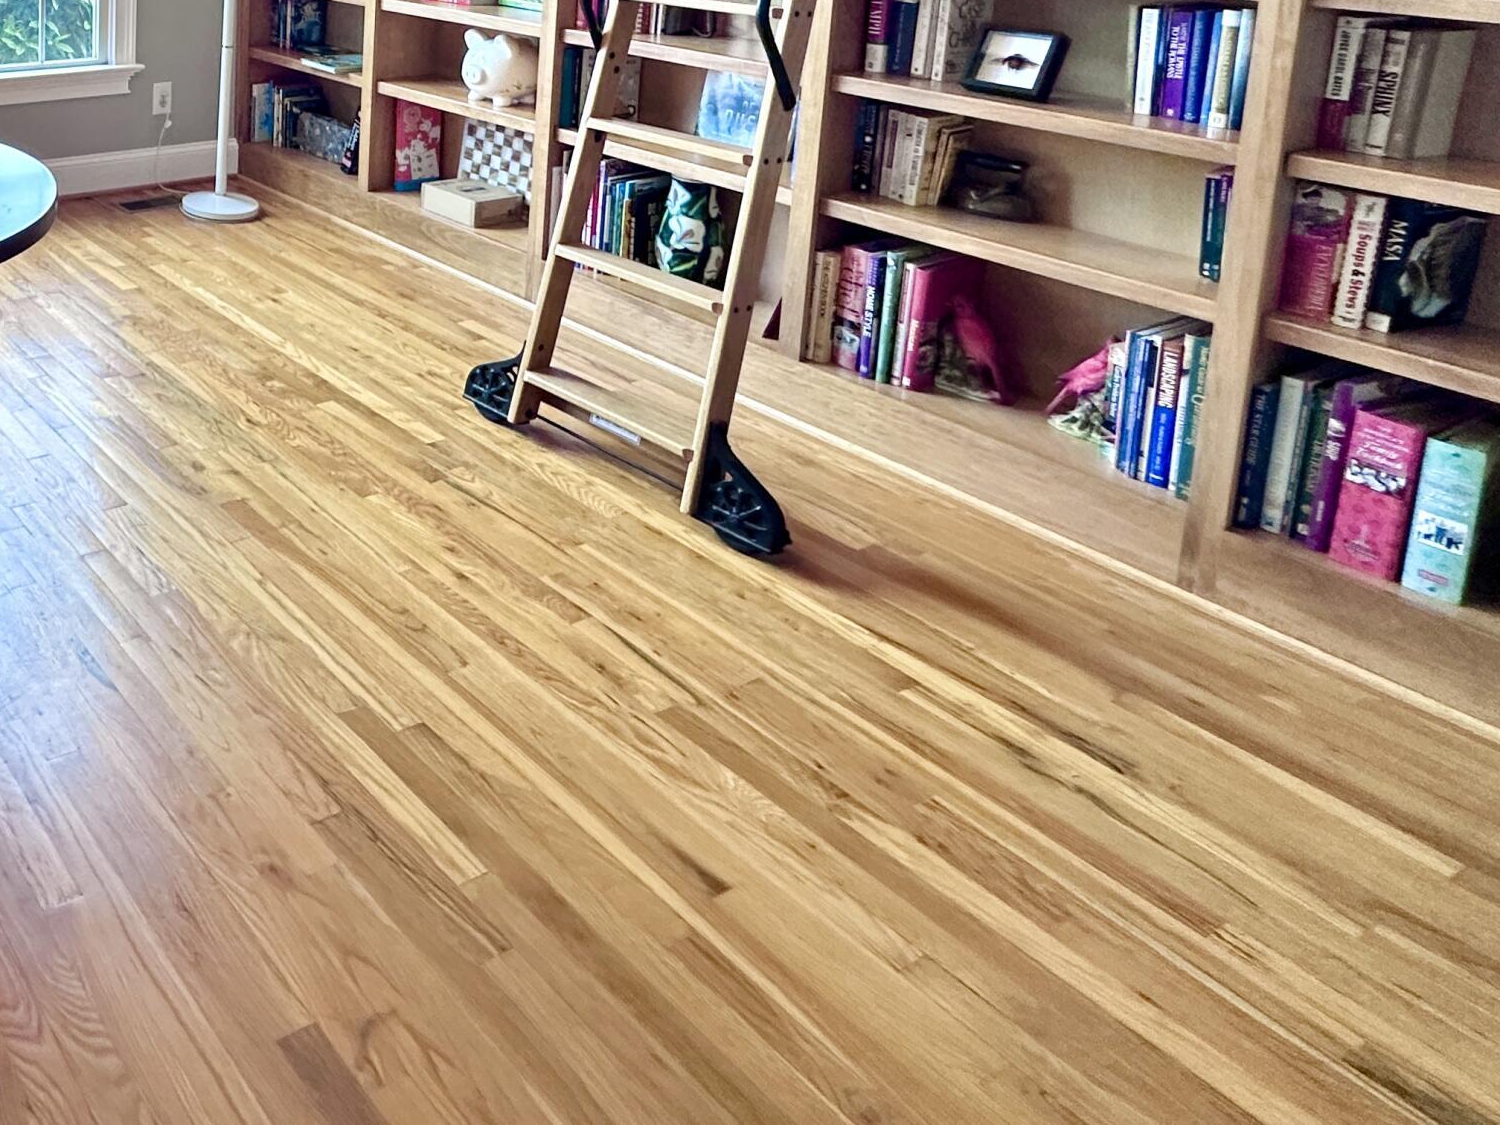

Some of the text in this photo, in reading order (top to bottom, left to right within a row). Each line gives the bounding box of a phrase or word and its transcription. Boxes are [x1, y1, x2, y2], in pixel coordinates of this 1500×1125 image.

[1371, 70, 1399, 118] SPHINX
[1382, 219, 1408, 262] MASA
[1344, 233, 1373, 310] Soups & Stews
[864, 286, 876, 312] HOME
[861, 310, 873, 339] STYLE
[1157, 351, 1179, 409] LANDSCAPING
[1250, 412, 1264, 436] STAR
[1324, 439, 1342, 462] SOUP
